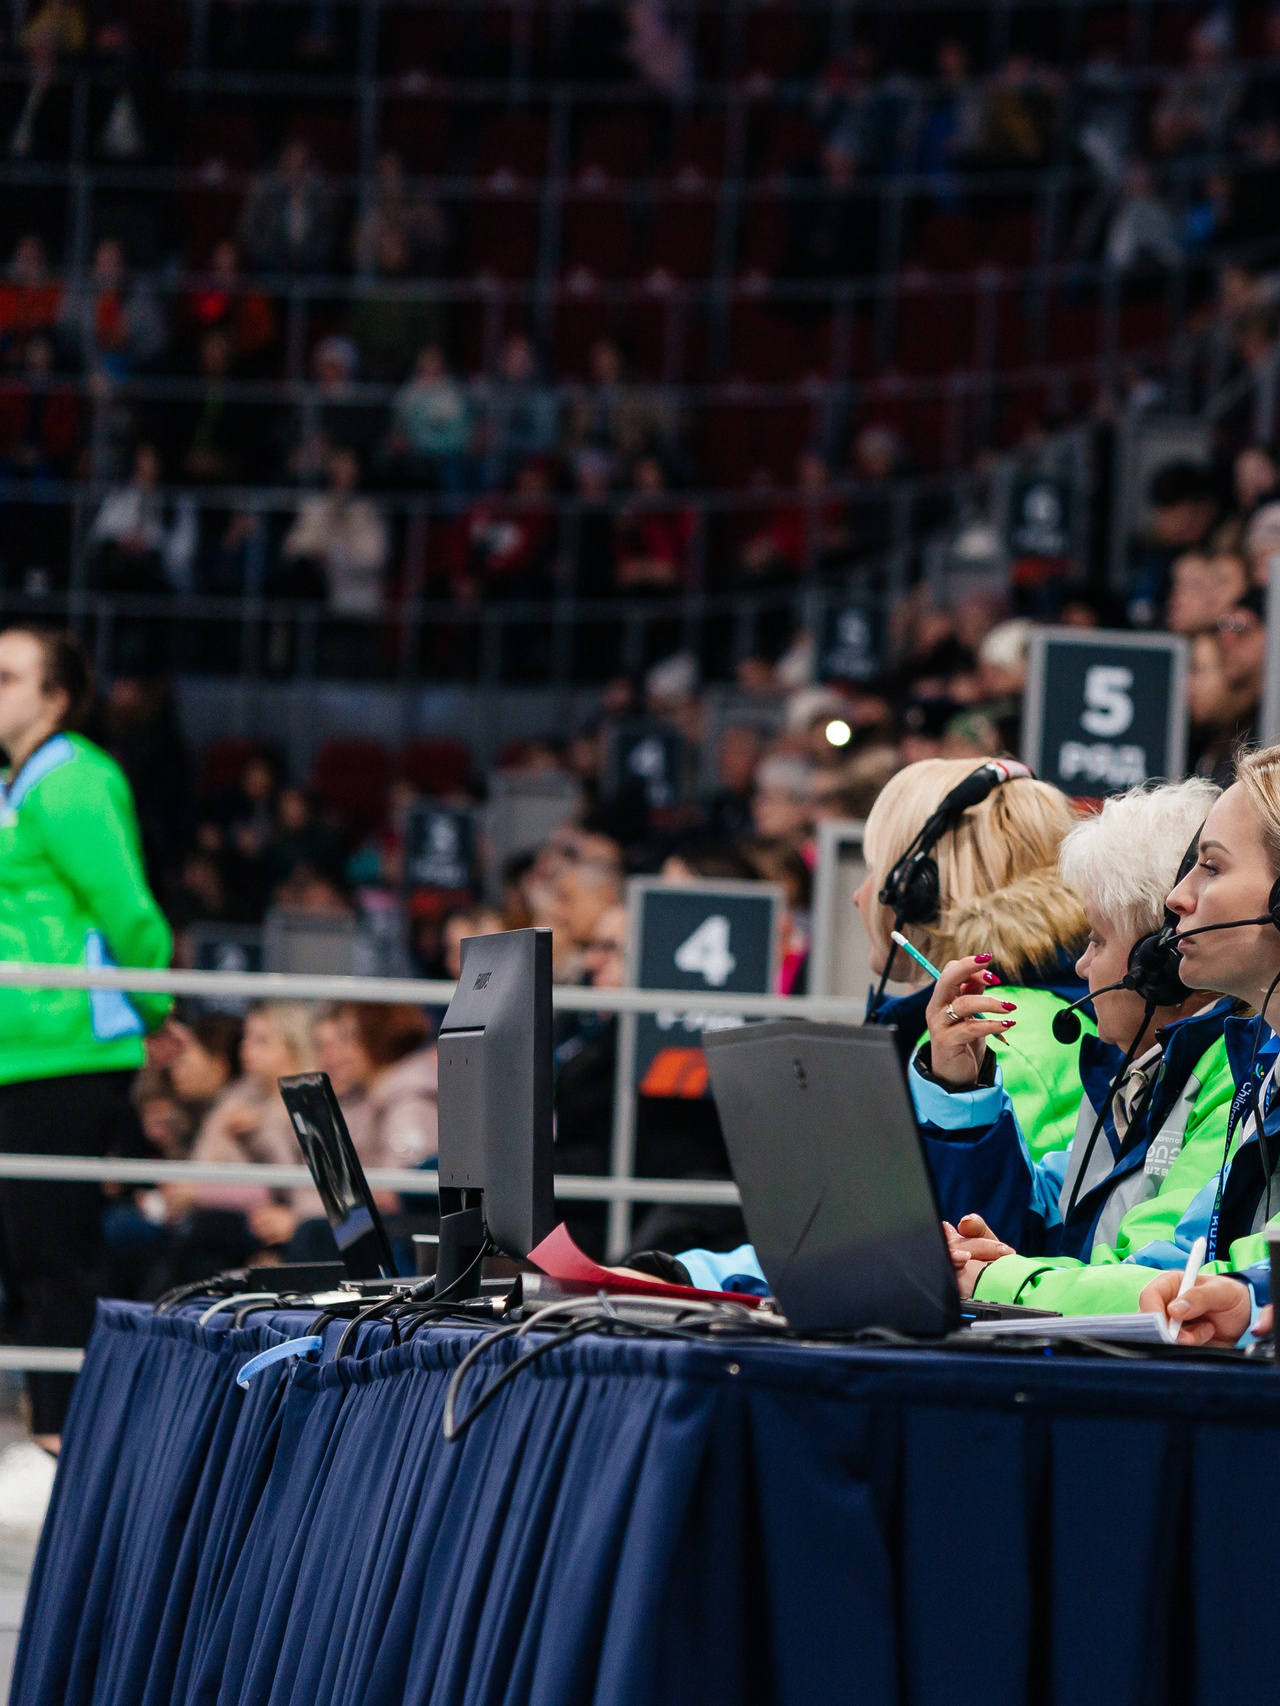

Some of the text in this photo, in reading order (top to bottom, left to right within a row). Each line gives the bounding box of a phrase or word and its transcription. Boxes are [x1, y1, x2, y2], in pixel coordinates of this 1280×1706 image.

[1081, 666, 1134, 737] 5
[674, 914, 736, 987] 4
[1229, 1082, 1251, 1127] Children
